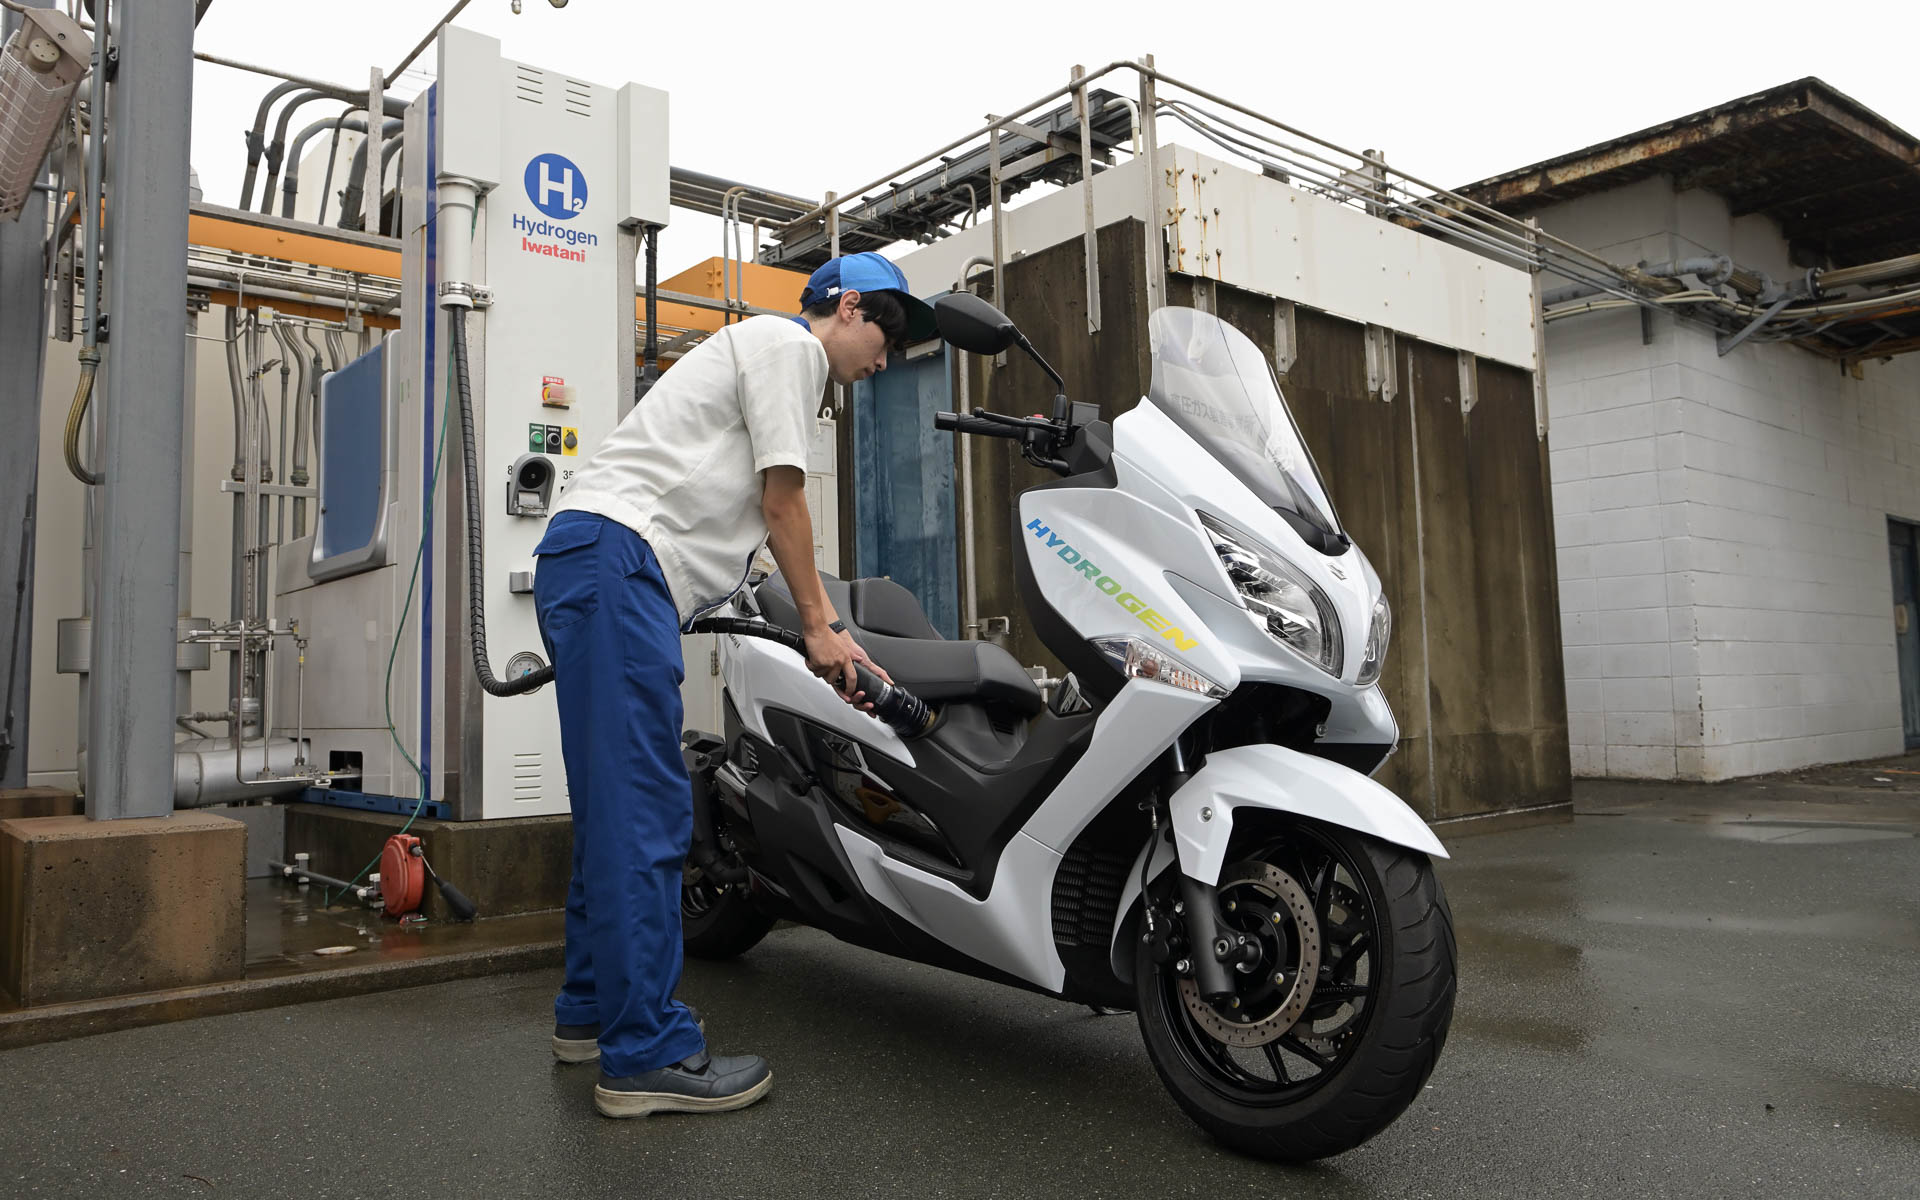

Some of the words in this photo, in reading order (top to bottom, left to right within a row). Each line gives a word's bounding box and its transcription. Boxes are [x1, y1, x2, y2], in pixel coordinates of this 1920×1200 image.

[512, 213, 598, 246] Hydrogen
[522, 237, 586, 263] Iwatani
[1026, 518, 1199, 652] HYDROGEN
